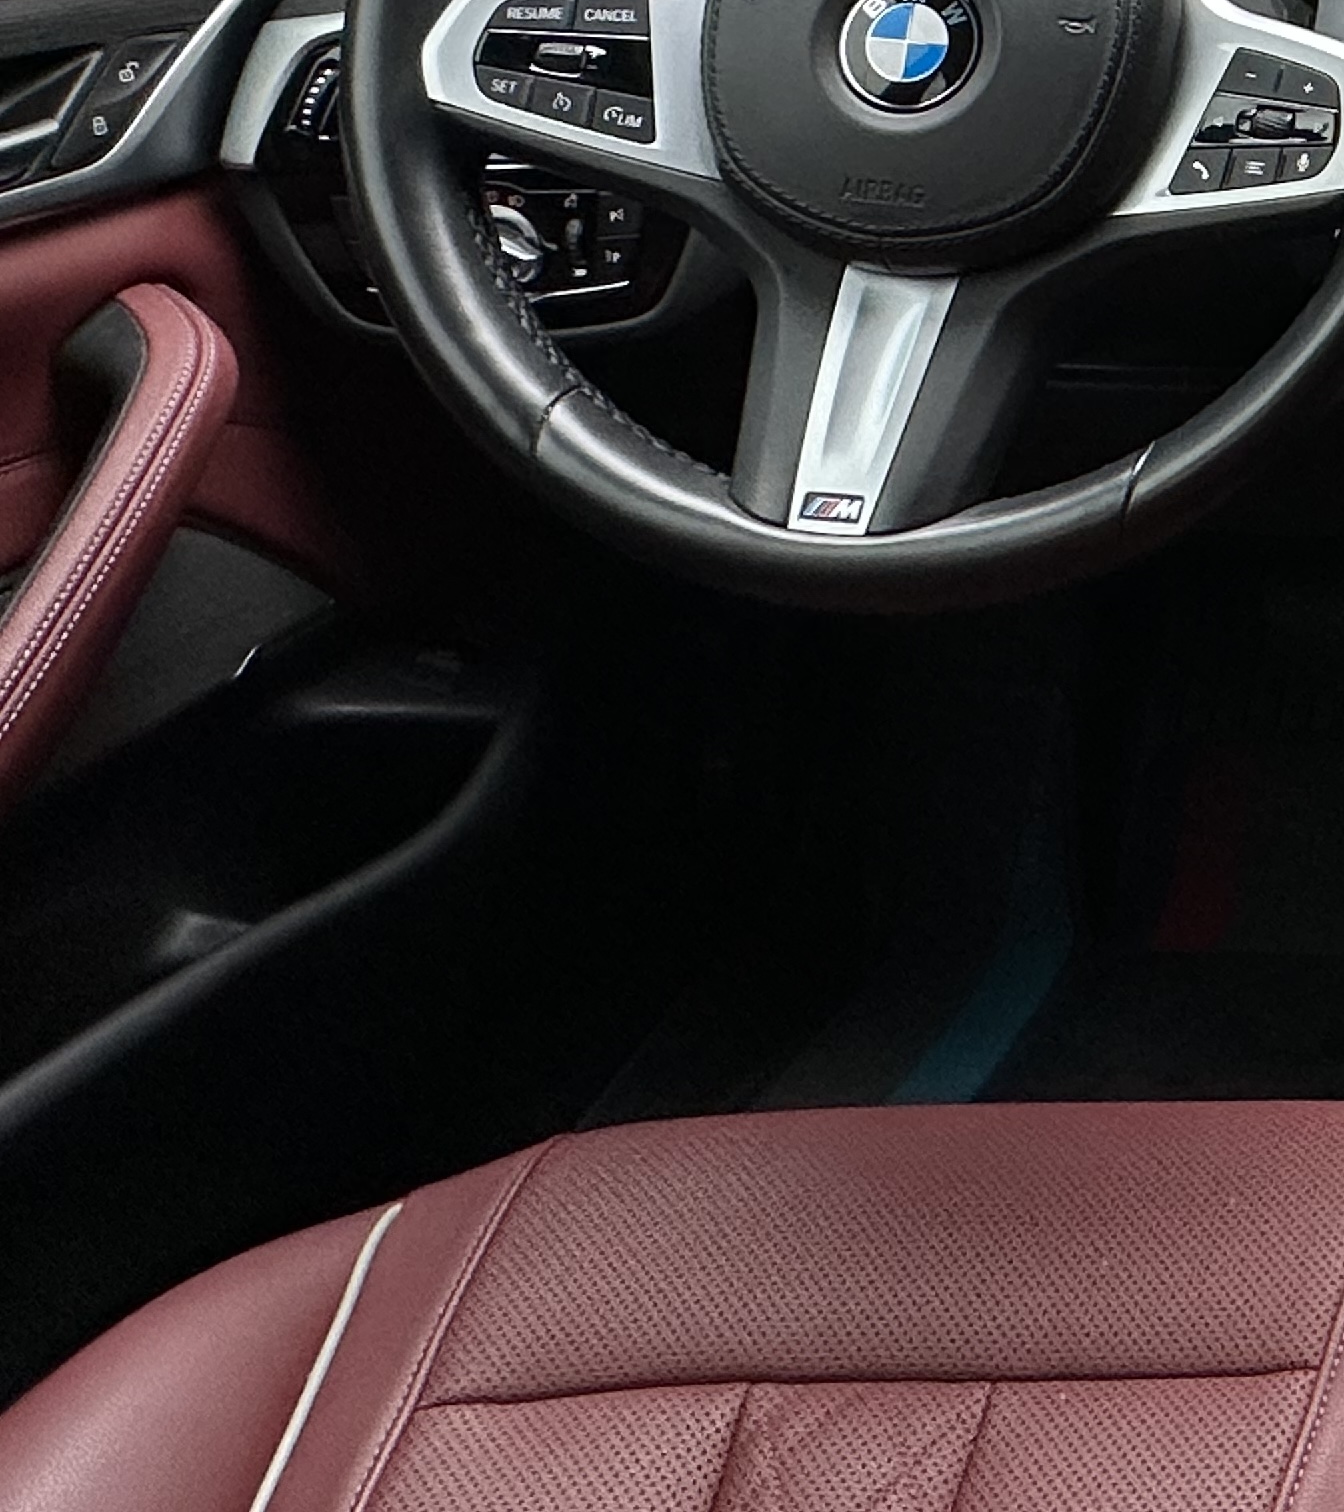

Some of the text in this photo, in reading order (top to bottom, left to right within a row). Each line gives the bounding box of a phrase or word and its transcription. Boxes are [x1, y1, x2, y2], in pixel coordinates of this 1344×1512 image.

[506, 6, 565, 21] RESUME
[583, 8, 638, 23] CANCEL
[490, 78, 518, 94] SET
[616, 112, 644, 128] LIM
[839, 176, 925, 208] AIRBAG
